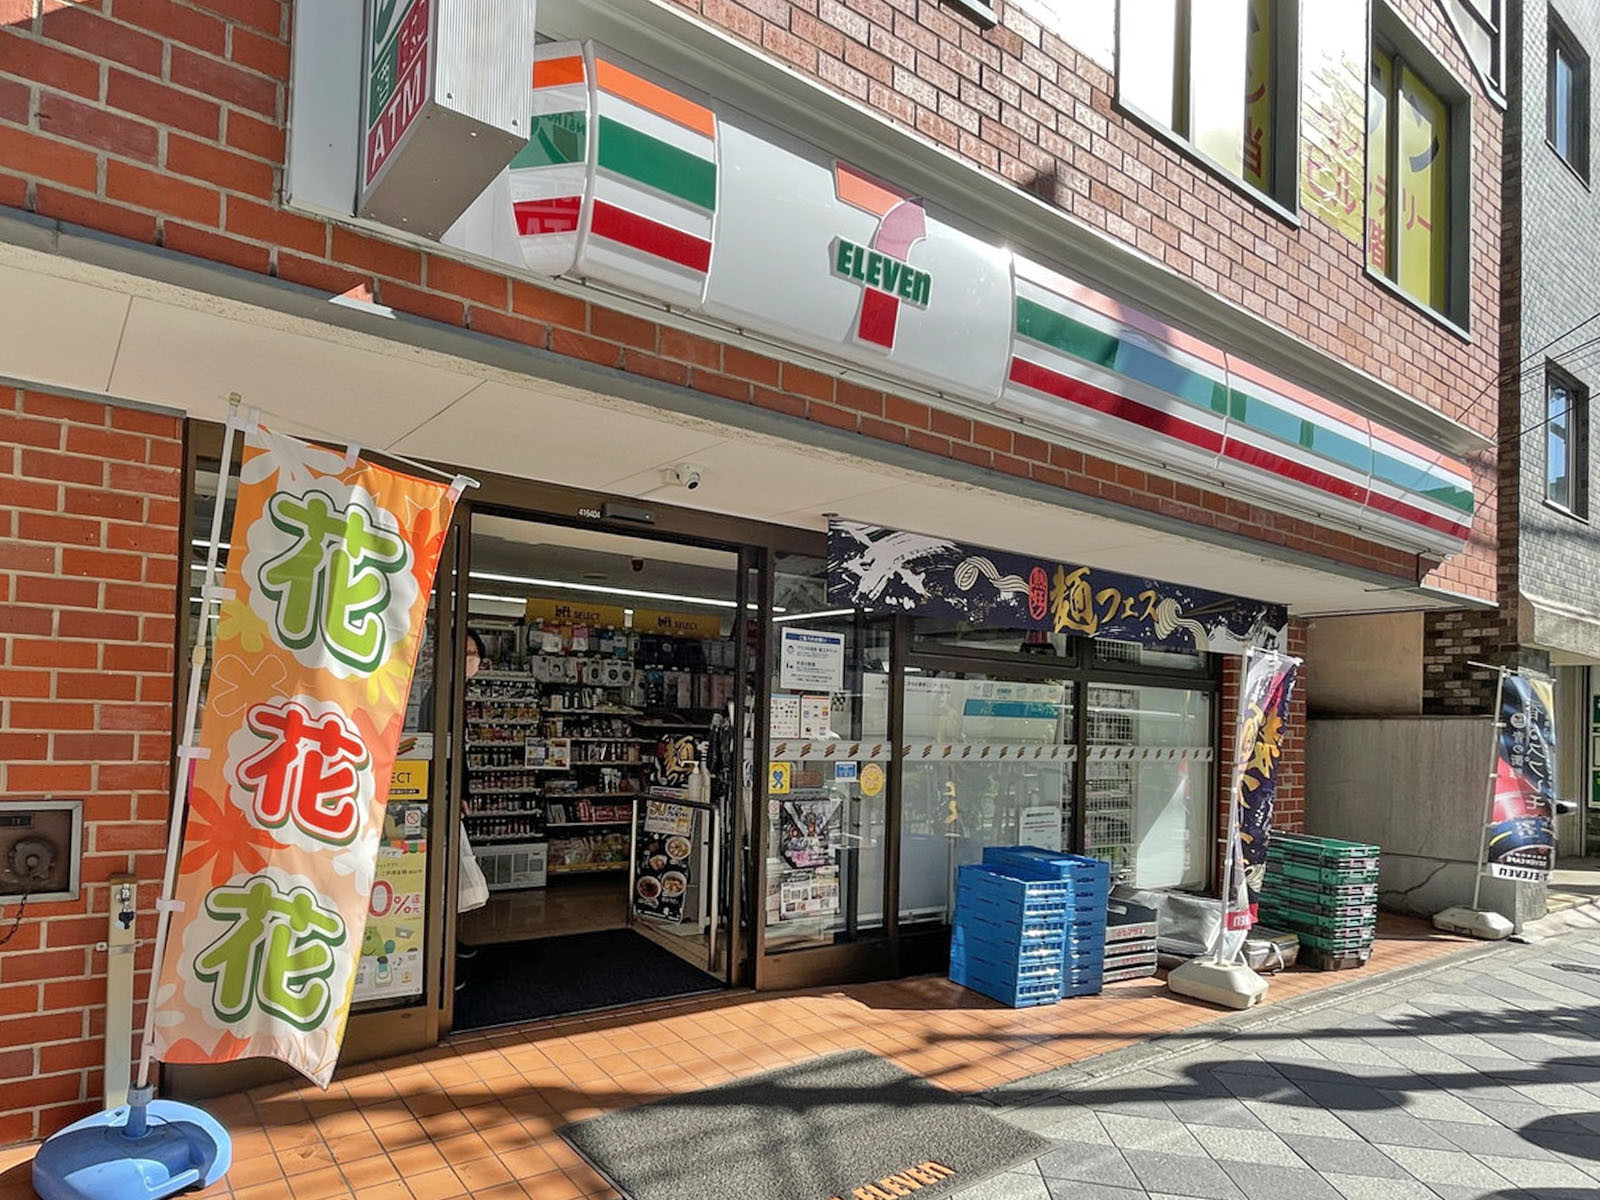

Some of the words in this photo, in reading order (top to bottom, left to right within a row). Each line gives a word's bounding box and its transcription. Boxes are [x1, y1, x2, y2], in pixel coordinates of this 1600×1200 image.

[372, 60, 422, 173] ATM
[260, 493, 406, 671] 花
[239, 703, 367, 842] 花
[196, 877, 345, 1028] 花
